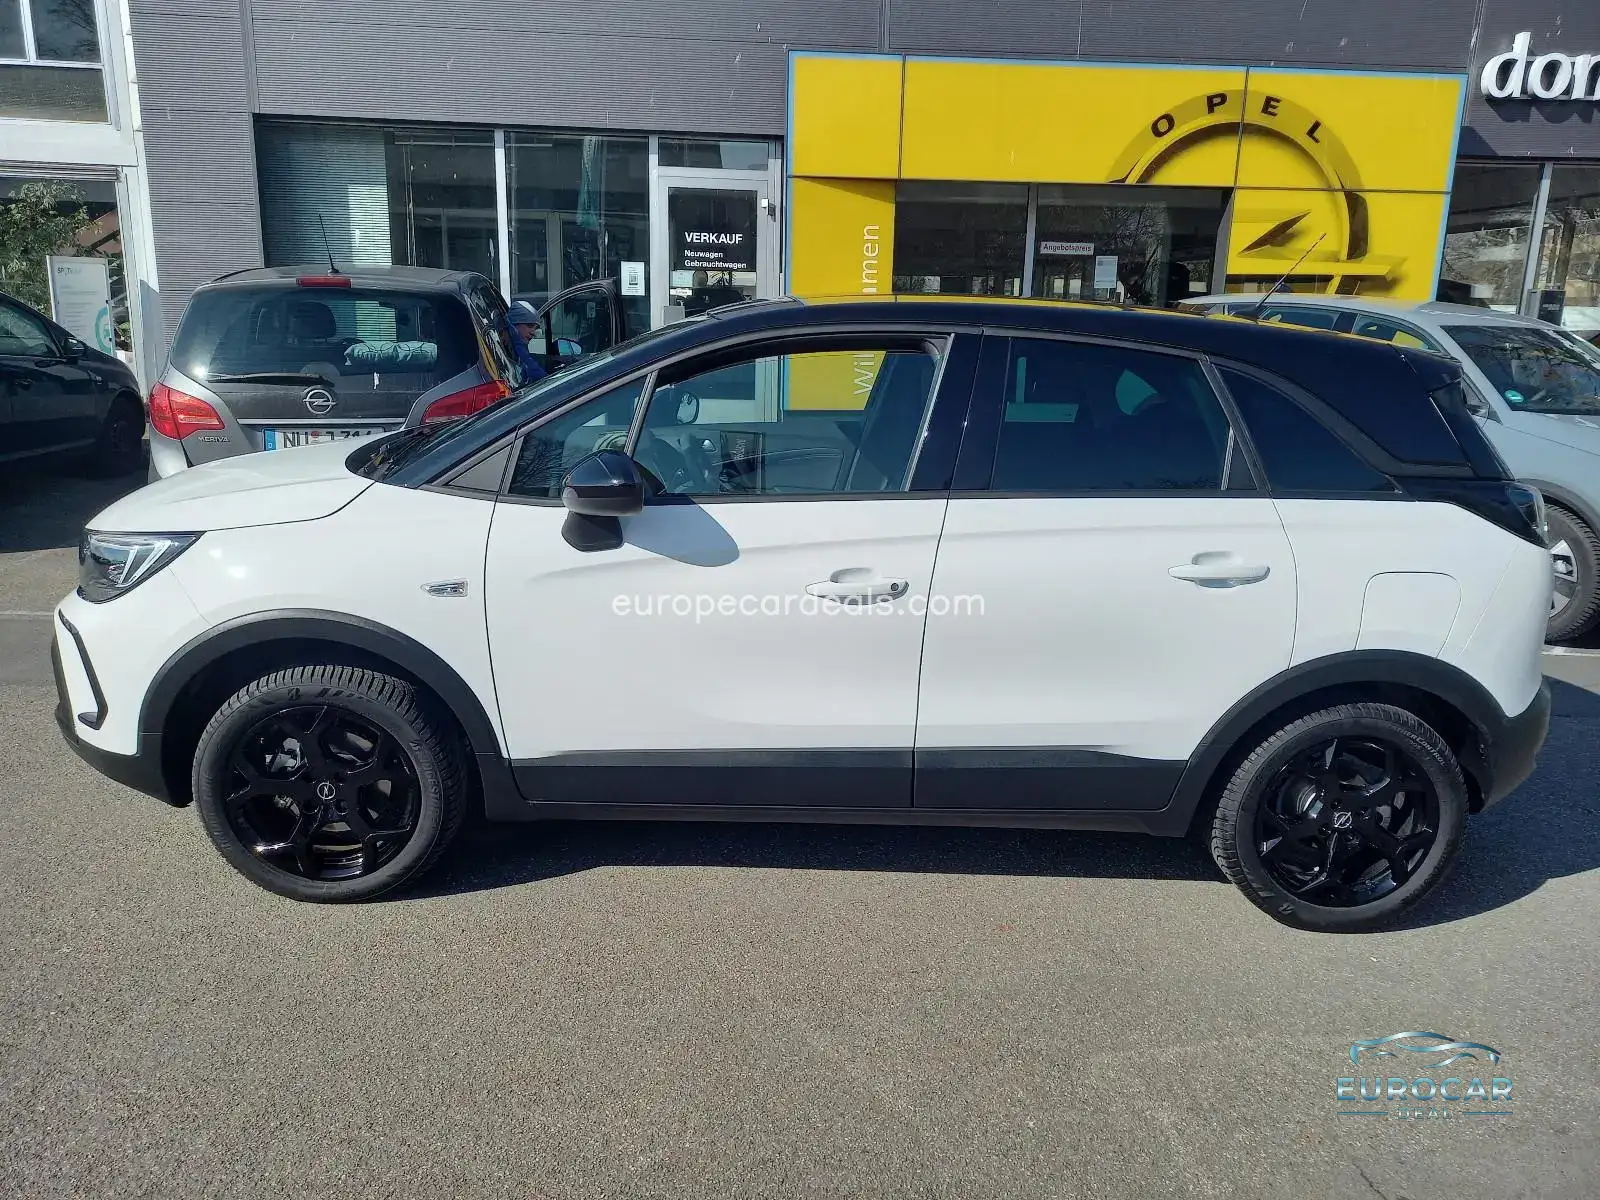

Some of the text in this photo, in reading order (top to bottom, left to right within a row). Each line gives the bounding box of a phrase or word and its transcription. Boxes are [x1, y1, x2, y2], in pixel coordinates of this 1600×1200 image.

[1151, 92, 1323, 143] OPEL
[684, 231, 743, 244] VERKAUF
[1043, 243, 1092, 253] Angebotspreis
[684, 250, 723, 259] Neuwagen
[684, 260, 747, 269] Gebrauchtwagen
